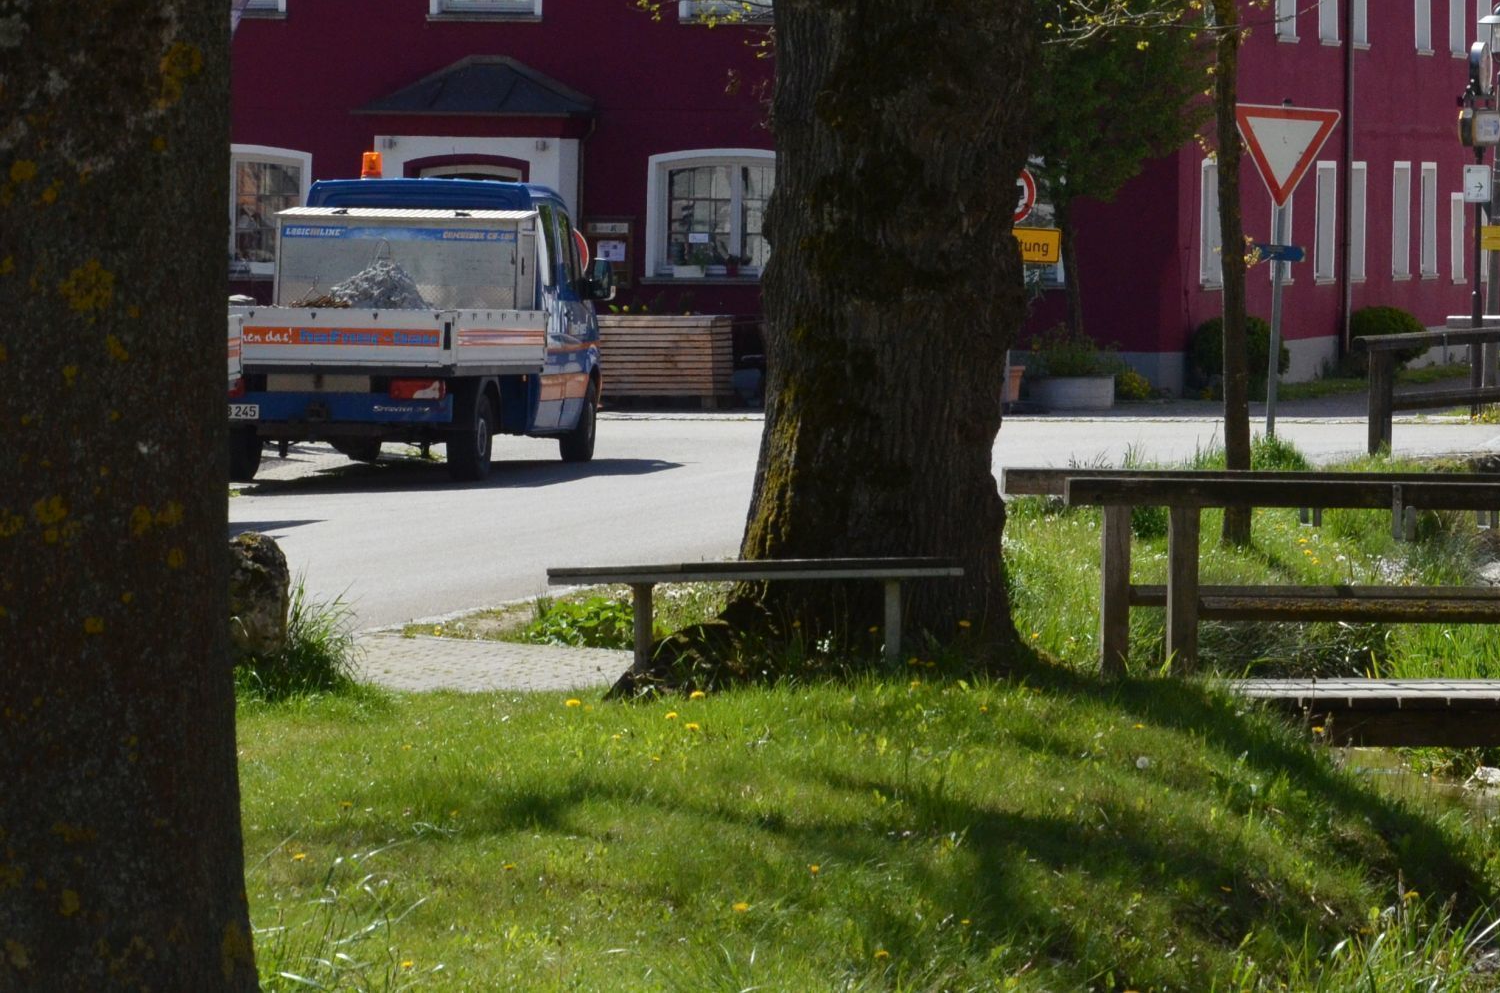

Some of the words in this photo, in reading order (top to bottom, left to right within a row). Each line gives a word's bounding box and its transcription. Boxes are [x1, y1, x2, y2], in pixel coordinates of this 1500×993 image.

[1020, 239, 1049, 256] tung
[266, 327, 292, 344] das!
[300, 329, 438, 346] hafner-bau
[235, 406, 256, 417] 245
